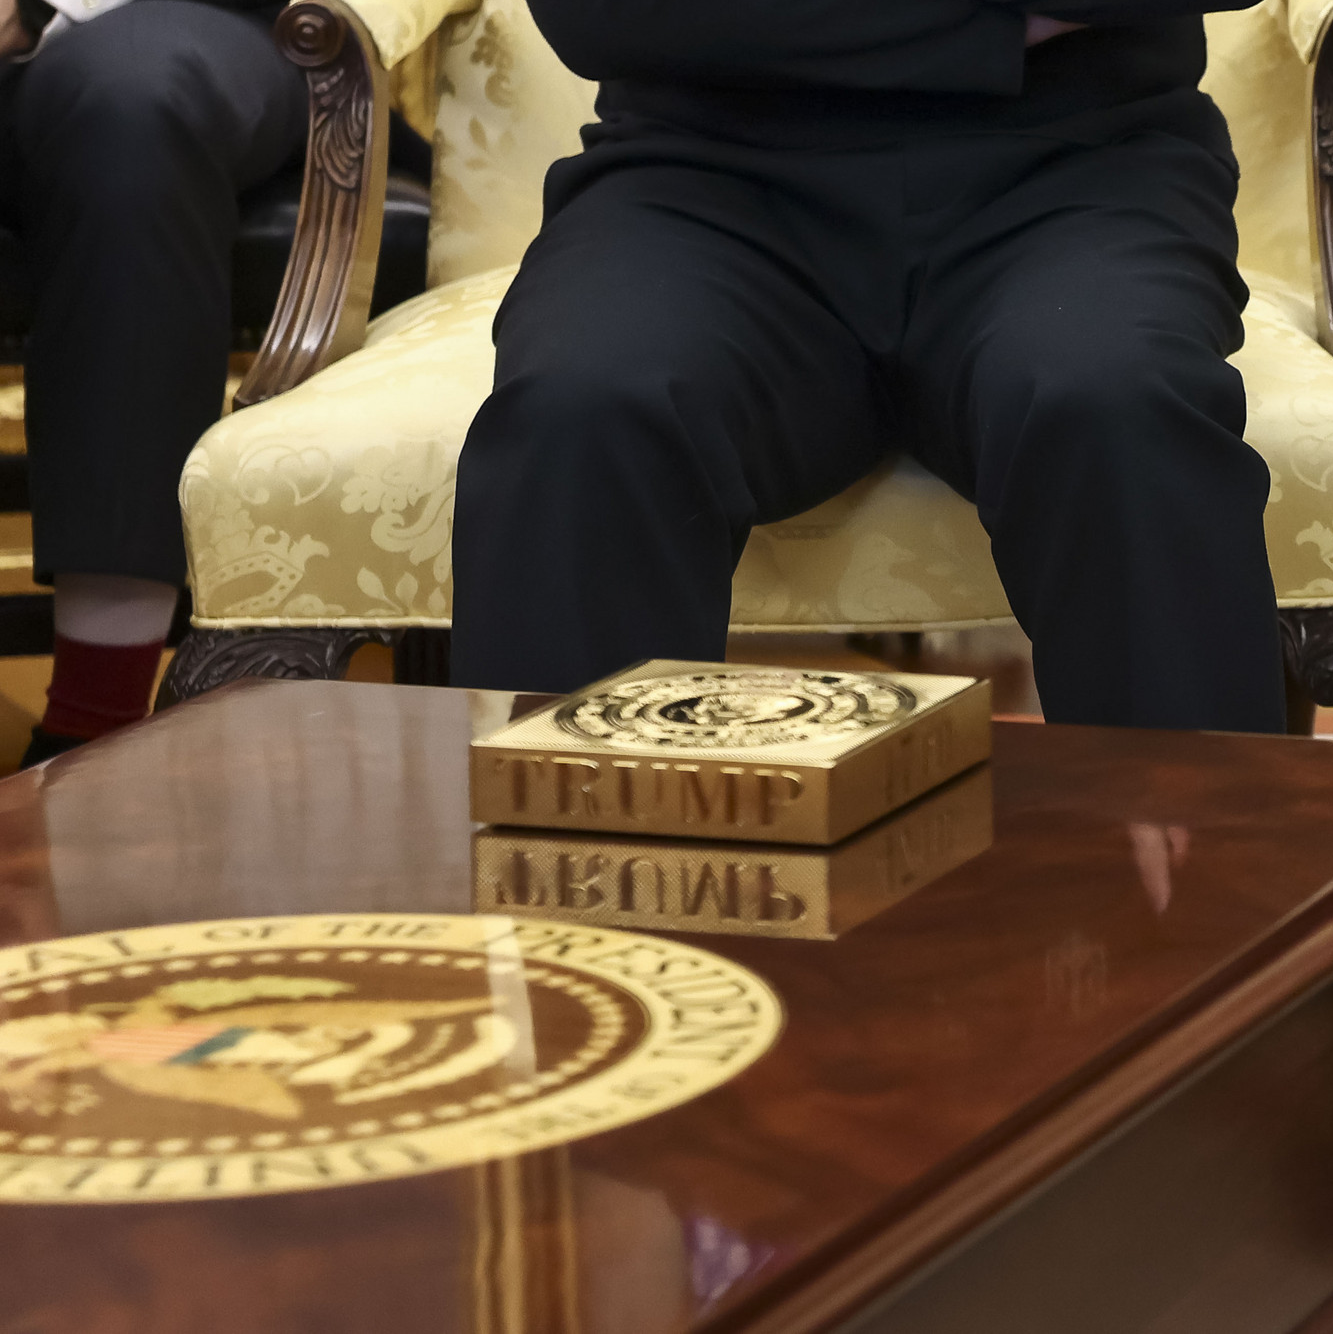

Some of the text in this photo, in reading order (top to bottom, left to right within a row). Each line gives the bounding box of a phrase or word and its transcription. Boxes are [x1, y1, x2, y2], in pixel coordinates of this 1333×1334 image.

[497, 755, 803, 826] TRUMP
[6, 937, 176, 978] AL
[203, 924, 294, 942] OF
[321, 921, 449, 938] THE
[480, 924, 760, 1064] PRESIDENT
